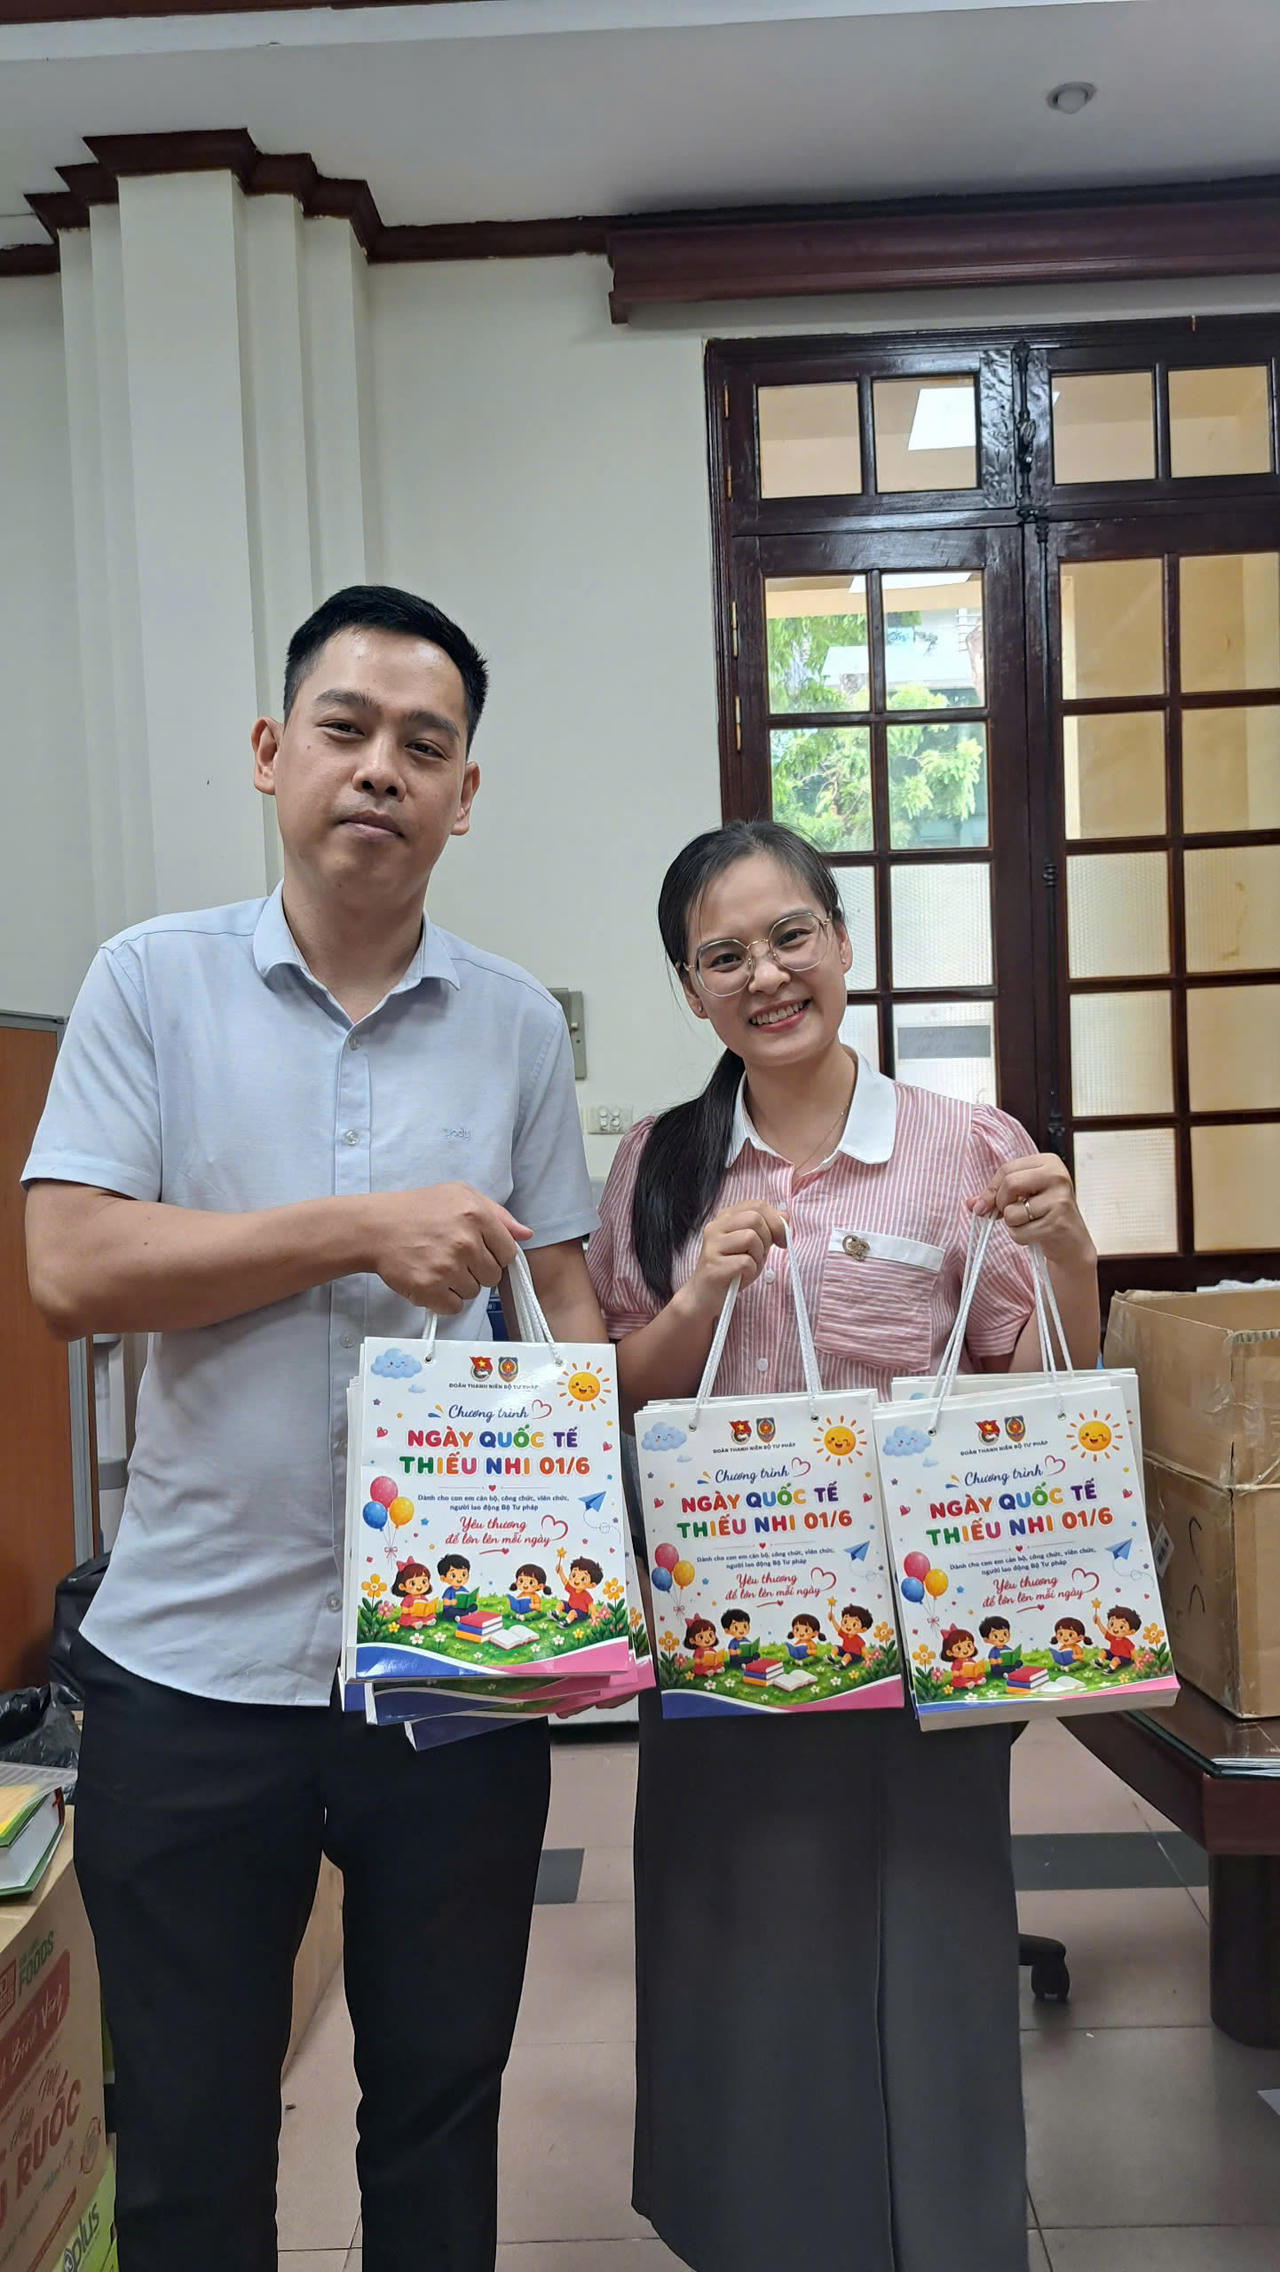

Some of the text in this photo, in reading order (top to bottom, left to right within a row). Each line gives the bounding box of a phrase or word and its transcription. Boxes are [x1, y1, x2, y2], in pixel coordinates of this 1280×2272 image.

[449, 1404, 529, 1423] Chương trình
[407, 1424, 578, 1449] NGÀY QUỐC TẾ
[399, 1451, 590, 1475] THIẾU NHI 01/6
[715, 1465, 789, 1484] Chương trình
[964, 1464, 1044, 1486] Chương trình
[681, 1481, 839, 1513] NGÀY QUỐC TẾ
[929, 1477, 1097, 1520] NGÀY QUỐC TẾ
[450, 1504, 469, 1512] người
[483, 1504, 500, 1512] động
[501, 1504, 511, 1512] Bộ
[522, 1504, 539, 1512] pháp
[459, 1515, 527, 1532] Yêu thương
[676, 1510, 852, 1539] THIẾU NHI 01/6
[926, 1506, 1113, 1546] THIẾU NHI 01/6
[445, 1531, 551, 1547] để lớn lên mỗi ngày
[726, 1561, 744, 1569] người
[755, 1560, 771, 1568] động
[772, 1559, 781, 1567] Bộ
[791, 1557, 807, 1566] pháp
[981, 1567, 1000, 1576] người
[1013, 1564, 1029, 1572] động
[1030, 1562, 1039, 1570] Bộ
[1050, 1559, 1067, 1568] pháp
[736, 1572, 797, 1588] Yêu thương
[993, 1576, 1058, 1594] Yêu thương
[725, 1584, 821, 1600] để lớn lên mỗi ngày
[982, 1587, 1083, 1608] để lớn lên mỗi ngày
[19, 1930, 54, 1997] FOODS
